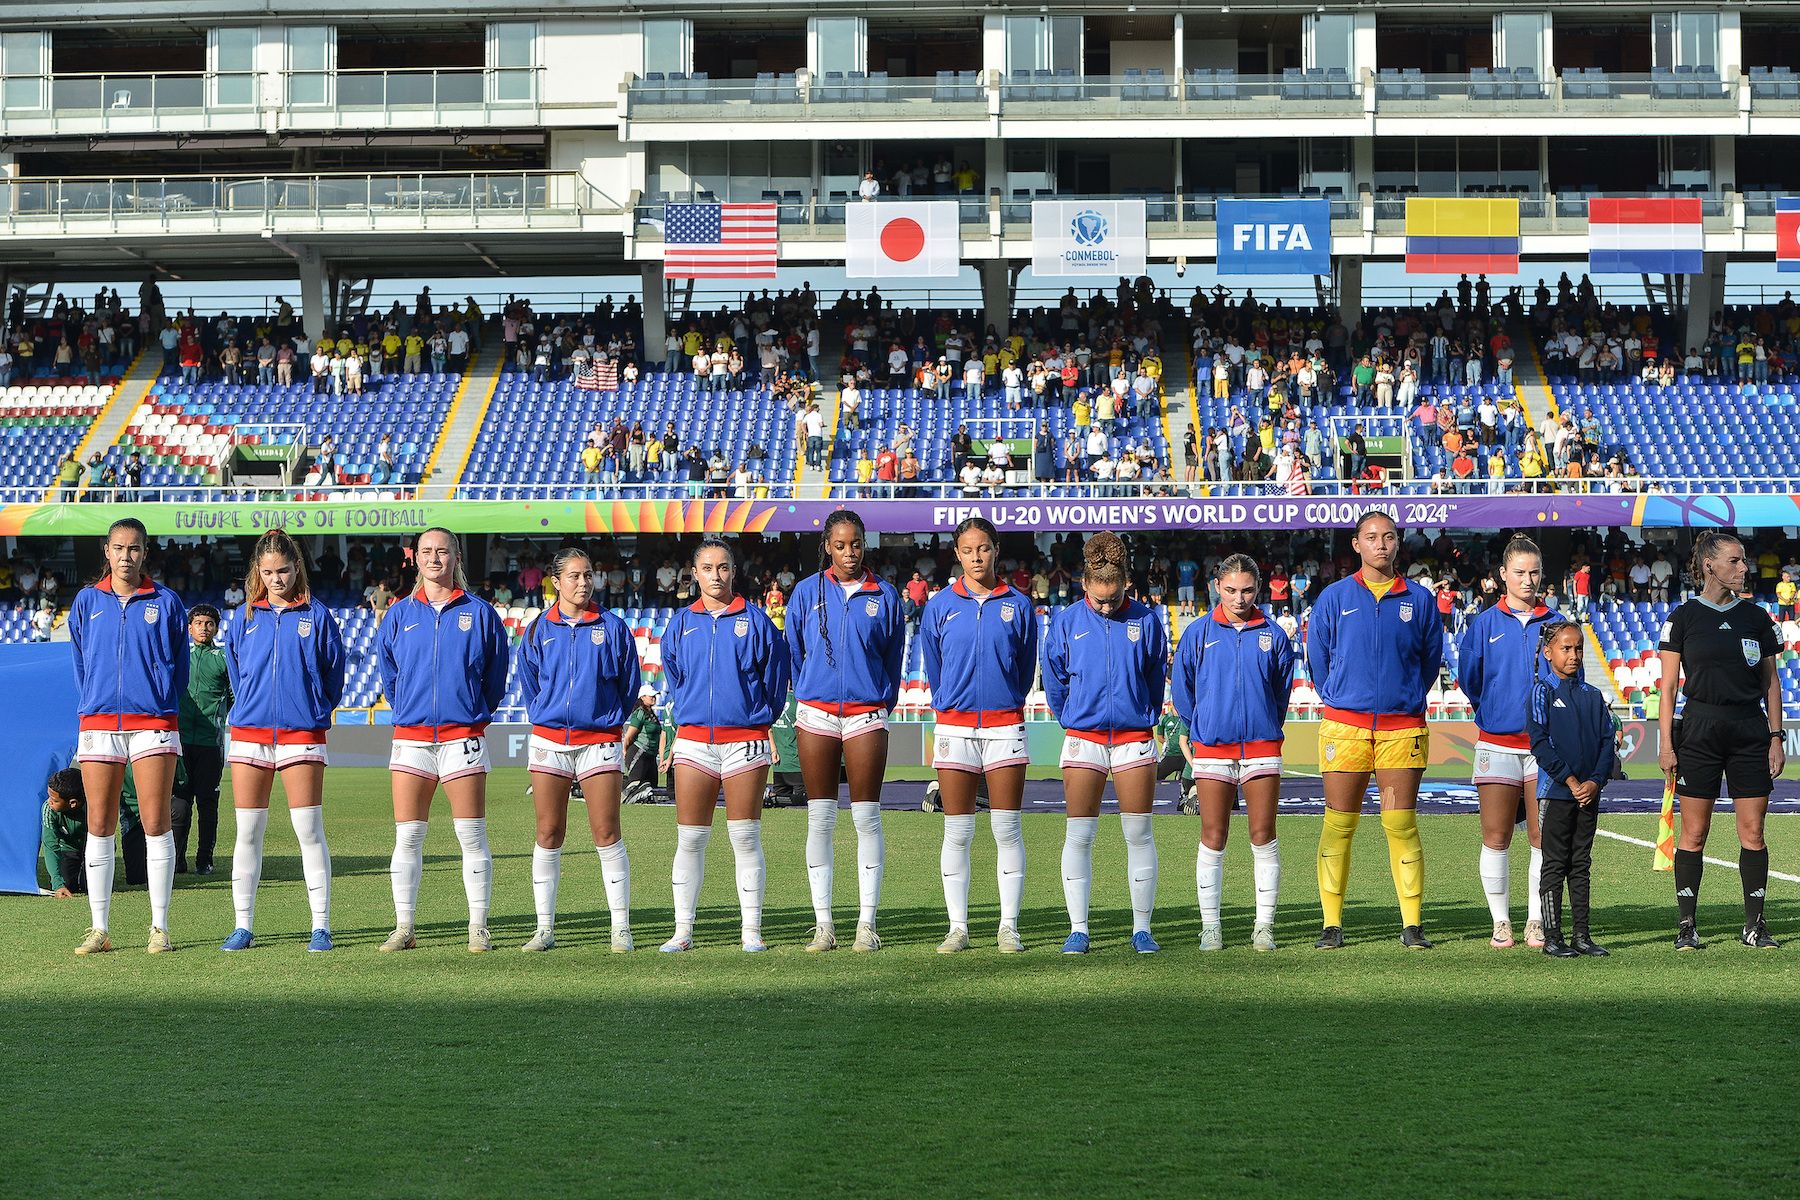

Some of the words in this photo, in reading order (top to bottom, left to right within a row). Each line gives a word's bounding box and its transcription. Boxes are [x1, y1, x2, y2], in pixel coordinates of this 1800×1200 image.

[1233, 223, 1313, 251] FIFA
[1066, 250, 1115, 261] CONMEBOL
[175, 510, 243, 529] FUTURE
[250, 509, 307, 529] STARS
[314, 510, 335, 528] OF
[345, 508, 428, 527] FOOTBALL
[933, 506, 984, 526] FIFA
[992, 506, 1041, 525] U-20
[1046, 505, 1157, 525] WOMEN'S
[1162, 504, 1247, 524] WORLD
[1253, 504, 1299, 523] CUP
